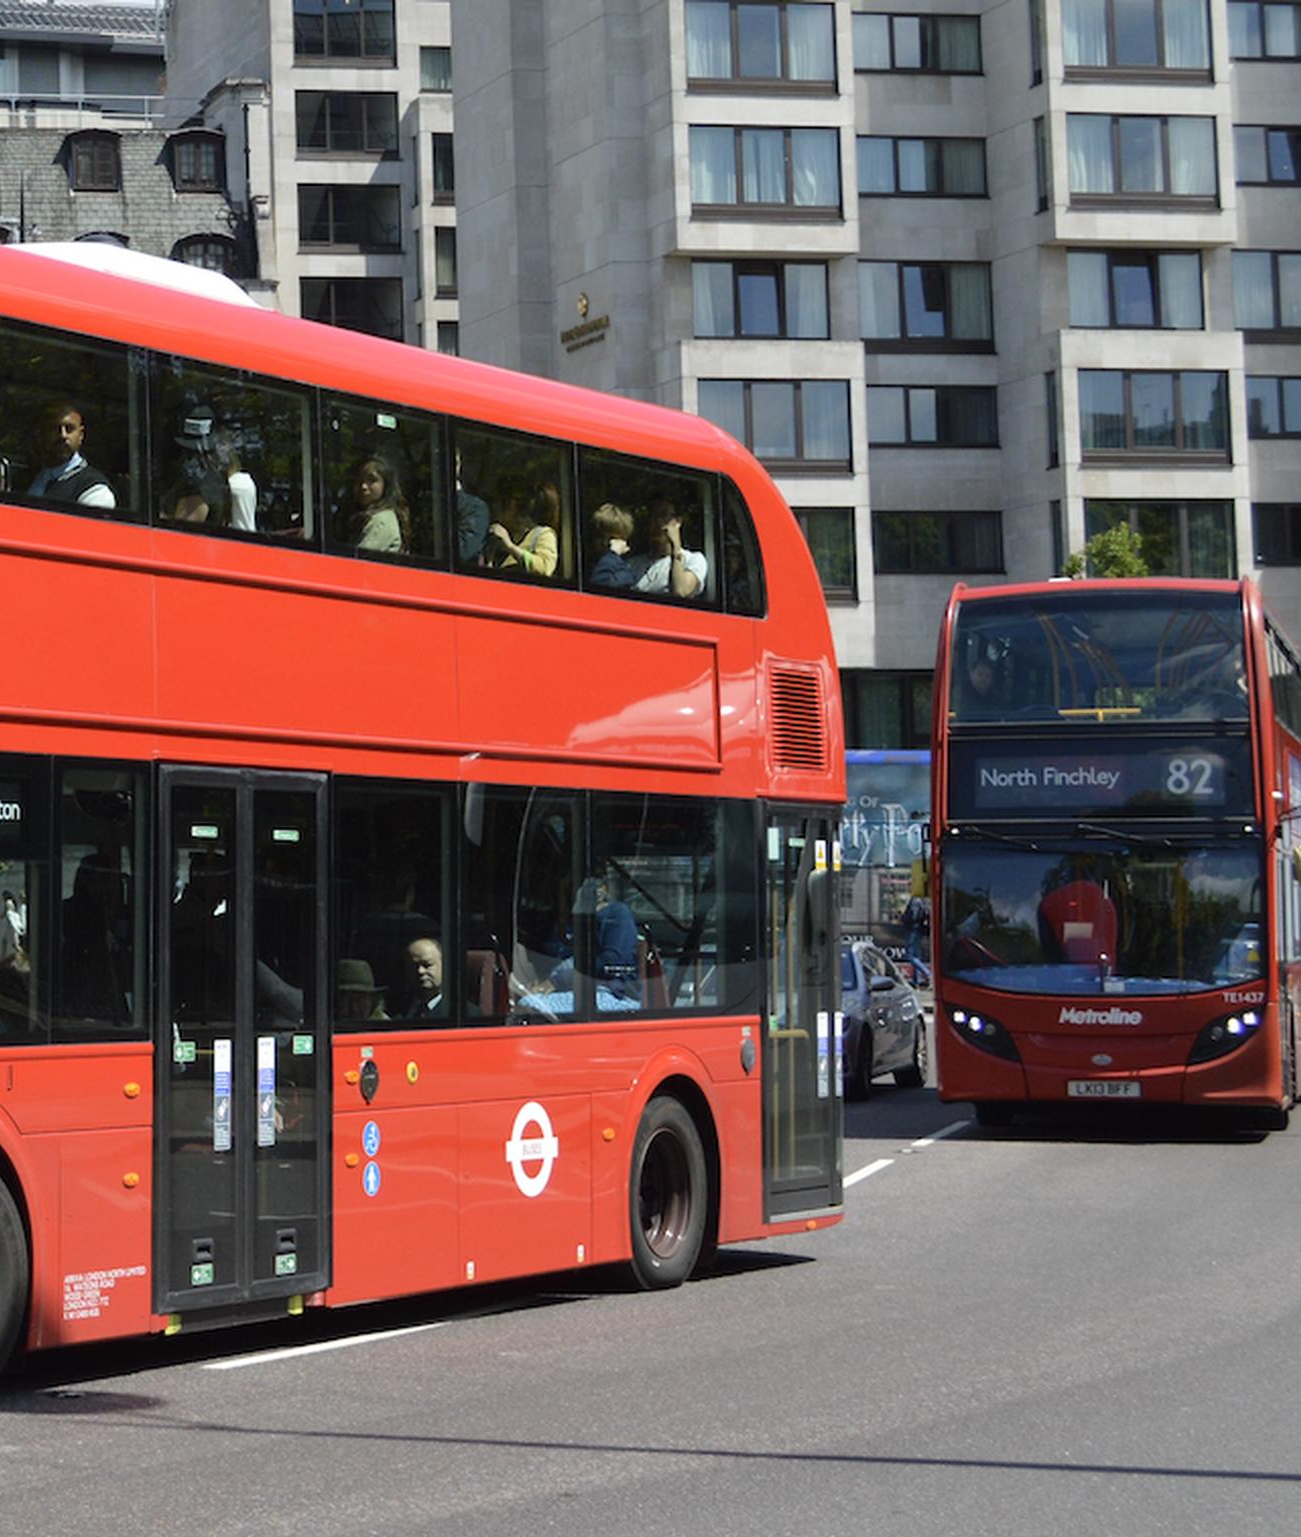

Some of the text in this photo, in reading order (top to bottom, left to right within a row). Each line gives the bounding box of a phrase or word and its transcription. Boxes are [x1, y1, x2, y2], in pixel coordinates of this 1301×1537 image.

[980, 766, 1120, 789] North Finchley
[1166, 758, 1214, 794] 82
[840, 934, 874, 945] OUR
[1222, 991, 1266, 1004] TE1437
[1058, 1007, 1143, 1025] Metroline
[1076, 1082, 1131, 1096] LK13 BFF
